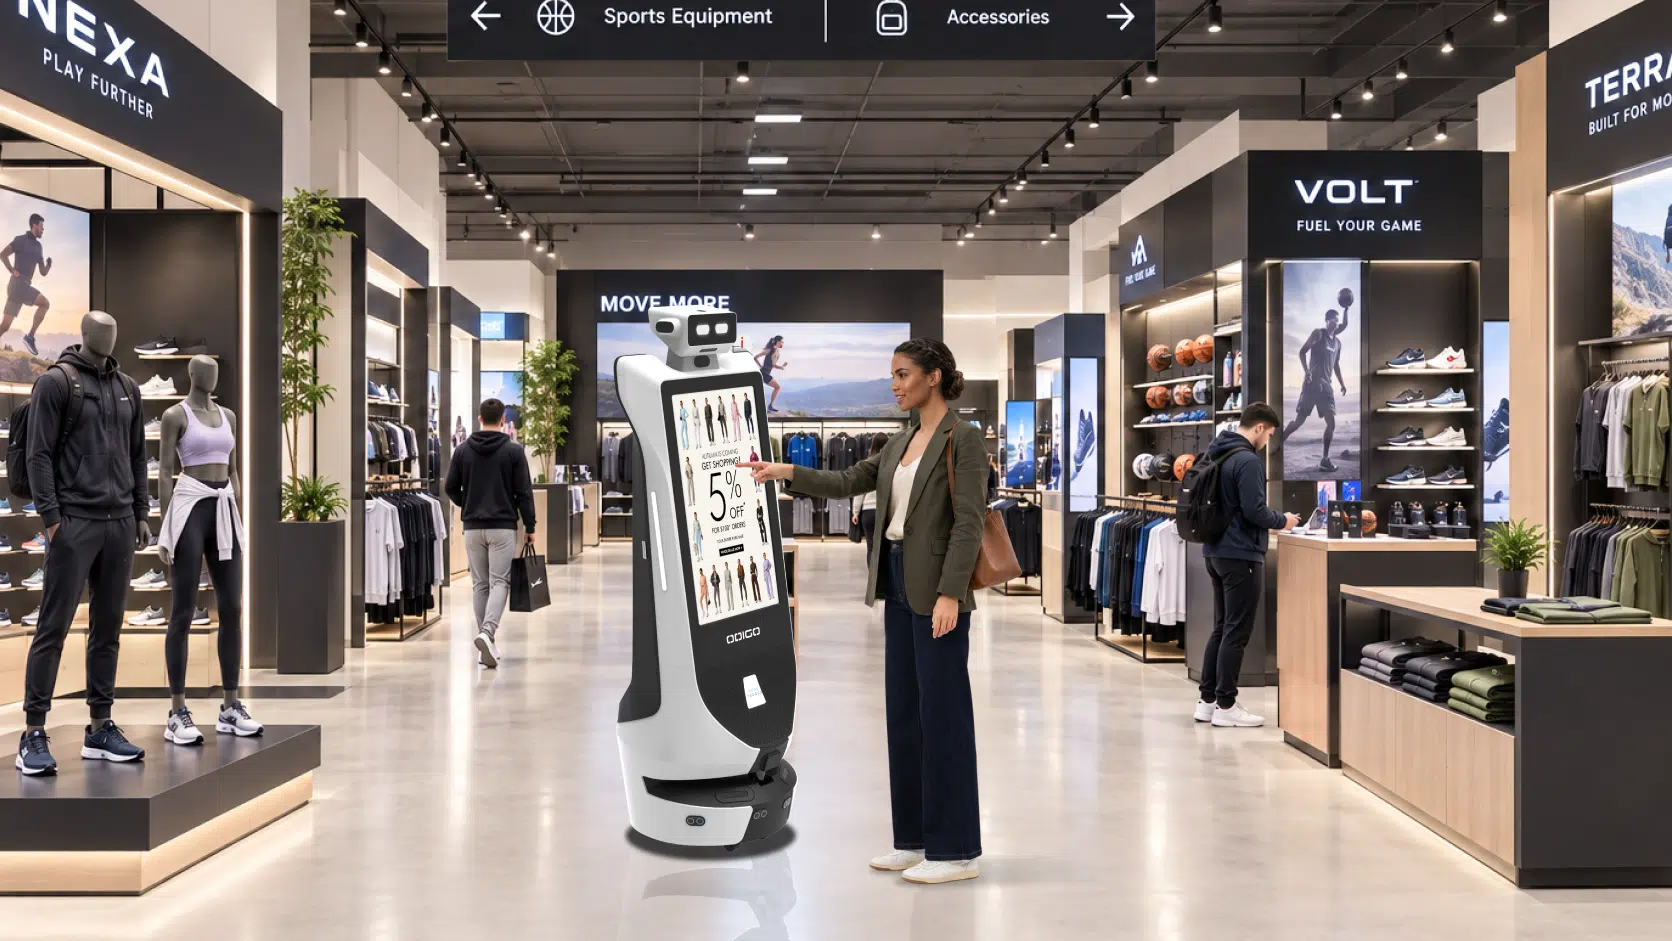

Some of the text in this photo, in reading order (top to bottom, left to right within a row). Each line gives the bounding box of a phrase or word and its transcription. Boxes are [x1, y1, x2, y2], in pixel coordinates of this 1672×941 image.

[604, 7, 773, 28] Sports Equipment
[947, 9, 1050, 24] Accessories
[19, 0, 169, 98] NEXA
[43, 48, 153, 119] PLAY FURTHER
[1588, 111, 1620, 135] BUILT
[1624, 101, 1648, 122] FOR
[1294, 180, 1413, 204] VOLT
[1297, 220, 1422, 231] FUEL YOUR GAME
[601, 295, 730, 312] MOVE MORE
[702, 456, 741, 470] GET SHOPPING!
[710, 469, 742, 521] 5%
[712, 525, 720, 534] FOR
